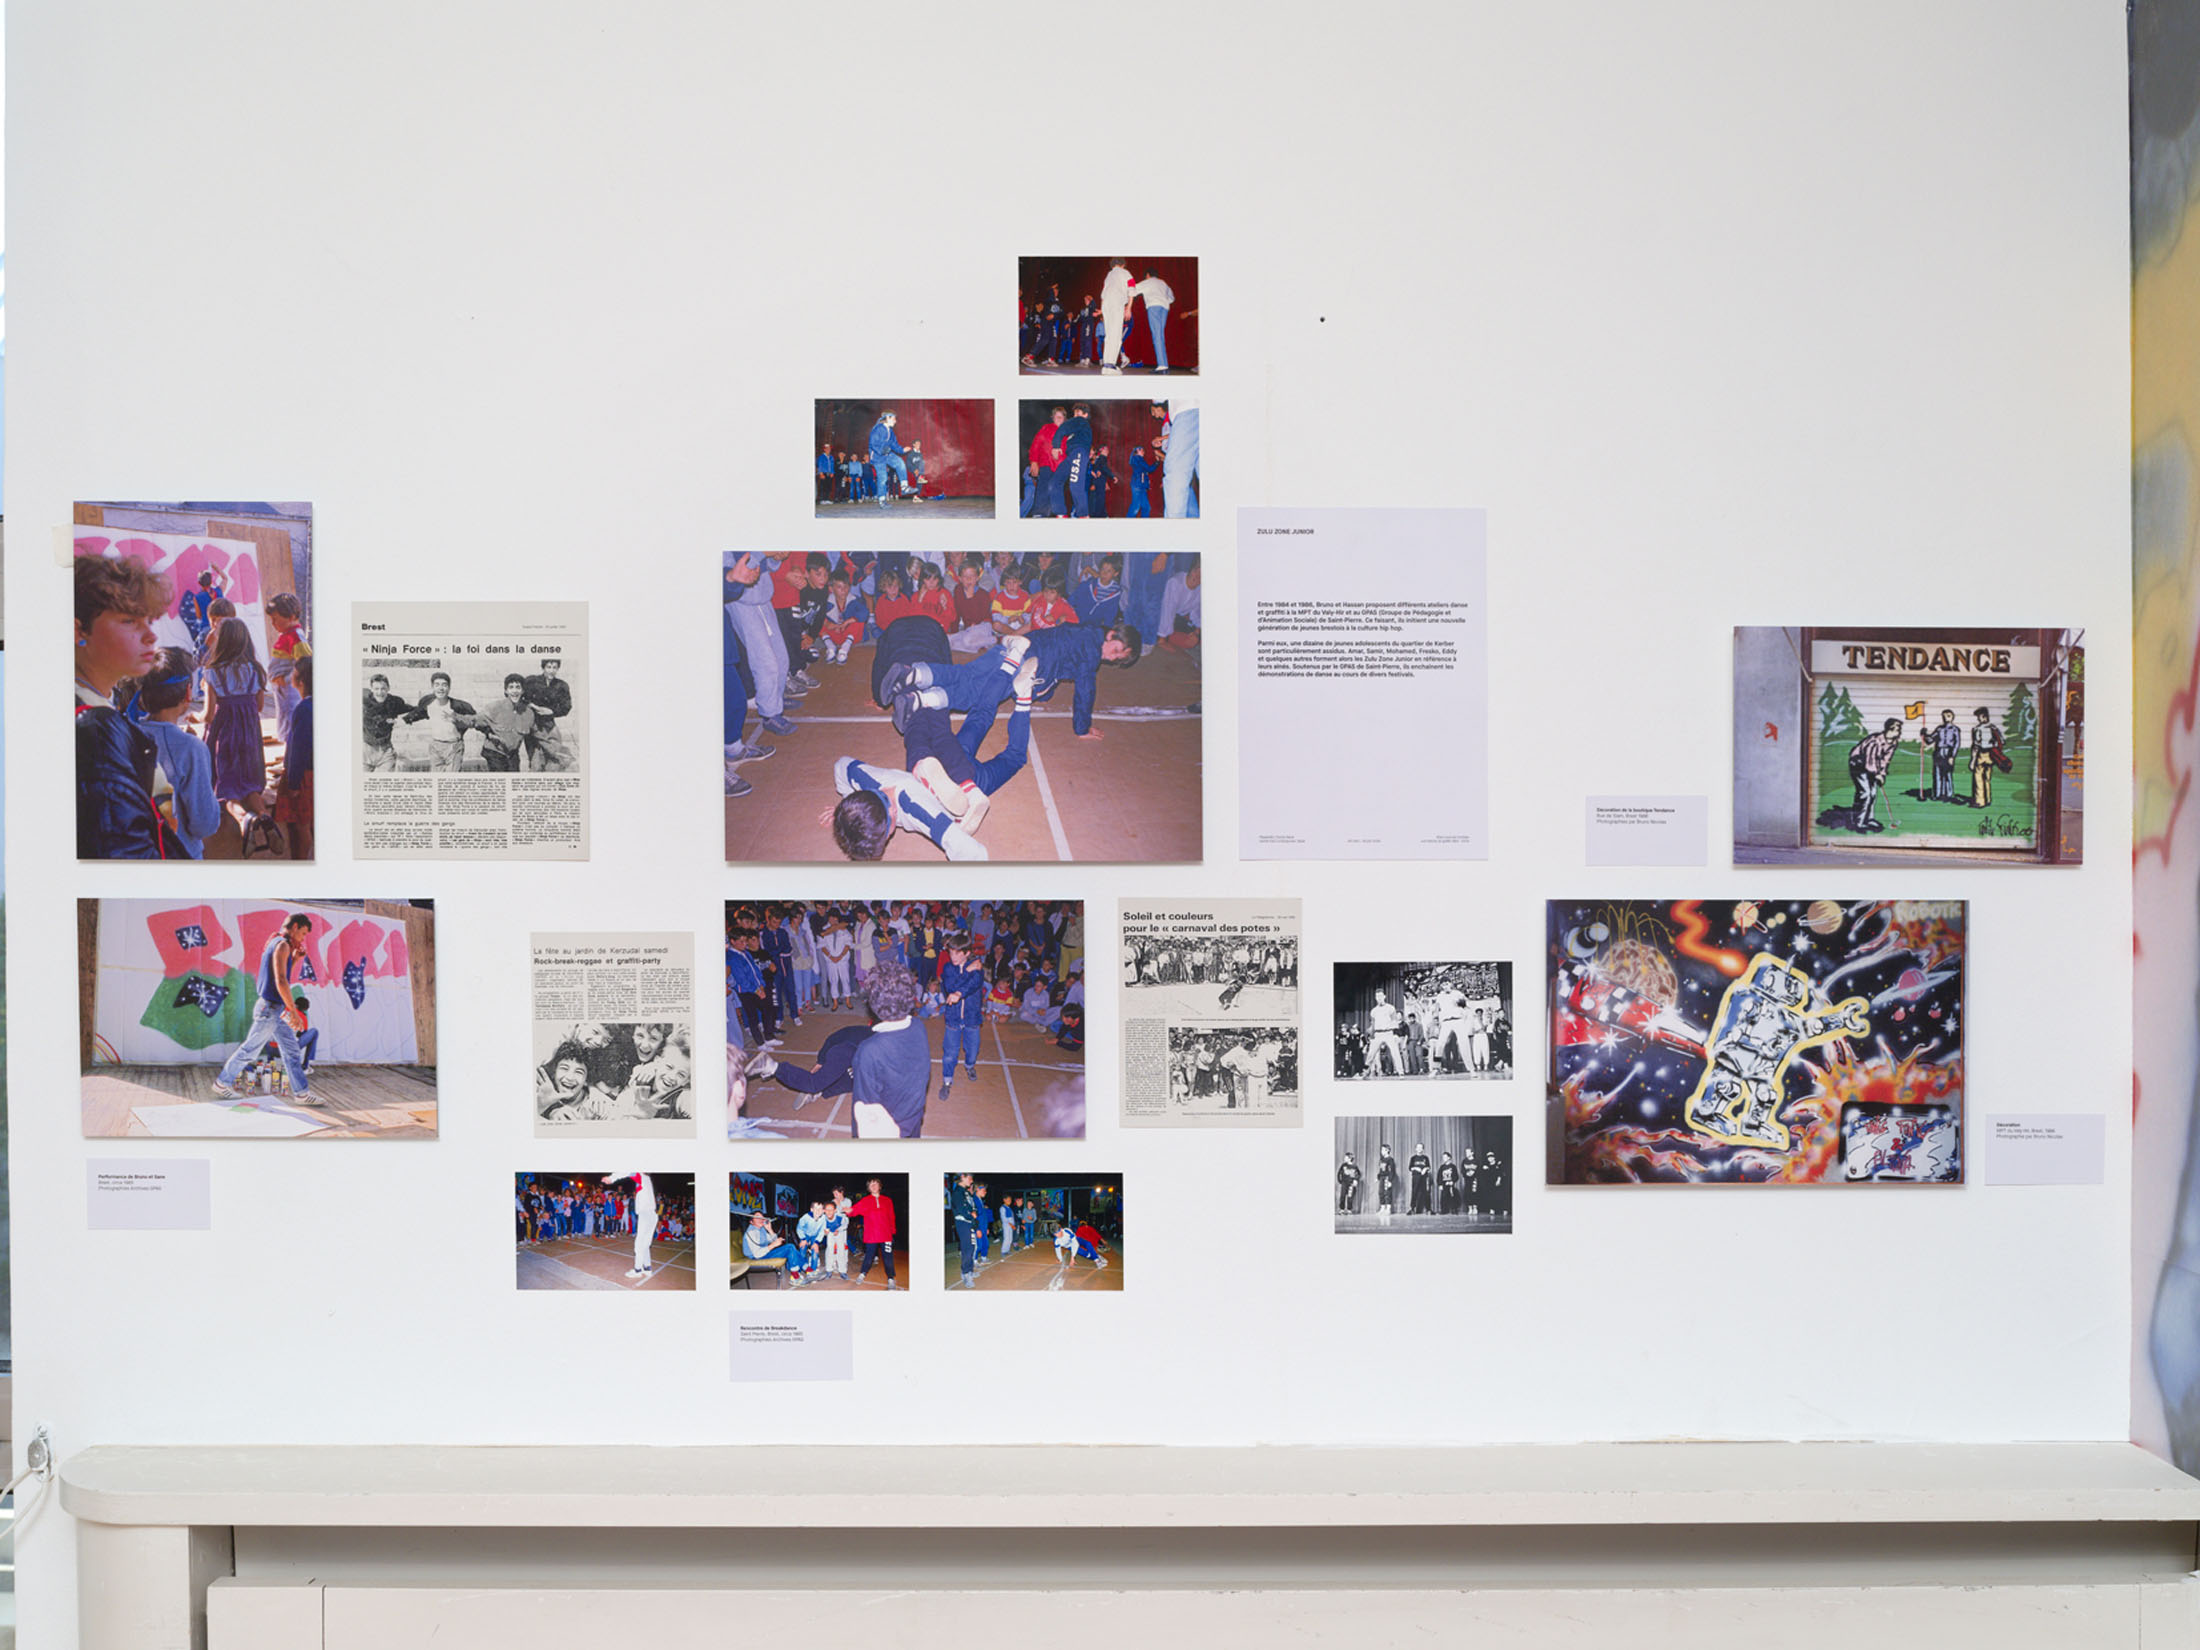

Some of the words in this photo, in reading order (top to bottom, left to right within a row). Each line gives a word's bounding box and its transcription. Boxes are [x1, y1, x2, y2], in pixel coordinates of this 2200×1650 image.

[361, 623, 385, 631] Brest
[371, 645, 397, 655] Ninja
[403, 645, 432, 653] Force
[452, 645, 461, 653] la
[467, 645, 480, 653] foi
[486, 645, 510, 653] dans
[516, 645, 525, 653] la
[531, 645, 561, 653] danse
[1843, 645, 2011, 673] TENDANCE
[1123, 912, 1152, 921] Soleil
[1155, 913, 1166, 921] et
[1169, 912, 1214, 921] couleurs
[1123, 926, 1146, 934] pour
[1150, 924, 1159, 932] le
[1172, 924, 1217, 932] carnaval
[1220, 924, 1237, 932] des
[1241, 925, 1270, 934] potes
[534, 958, 601, 966] Rock-break-reggae
[617, 958, 661, 966] graffiti-party
